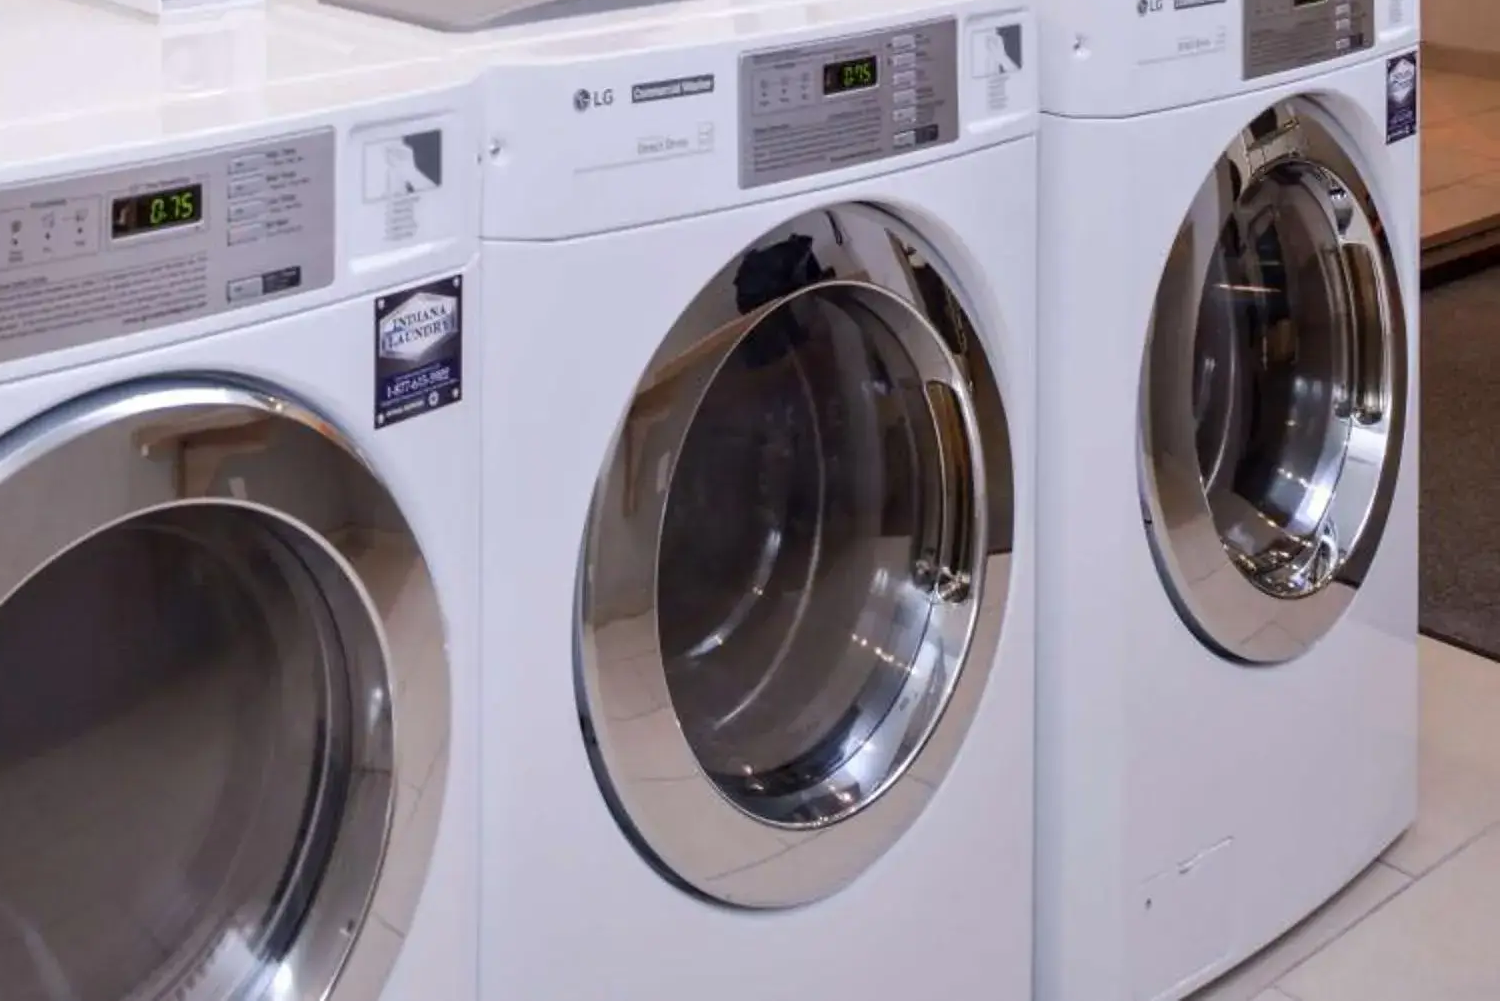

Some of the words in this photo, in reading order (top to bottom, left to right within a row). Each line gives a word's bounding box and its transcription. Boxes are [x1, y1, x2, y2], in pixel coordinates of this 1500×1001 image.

[593, 88, 614, 108] LG
[150, 192, 194, 224] 0.75
[388, 316, 452, 348] LAUNDRY
[393, 303, 448, 332] INDIANA
